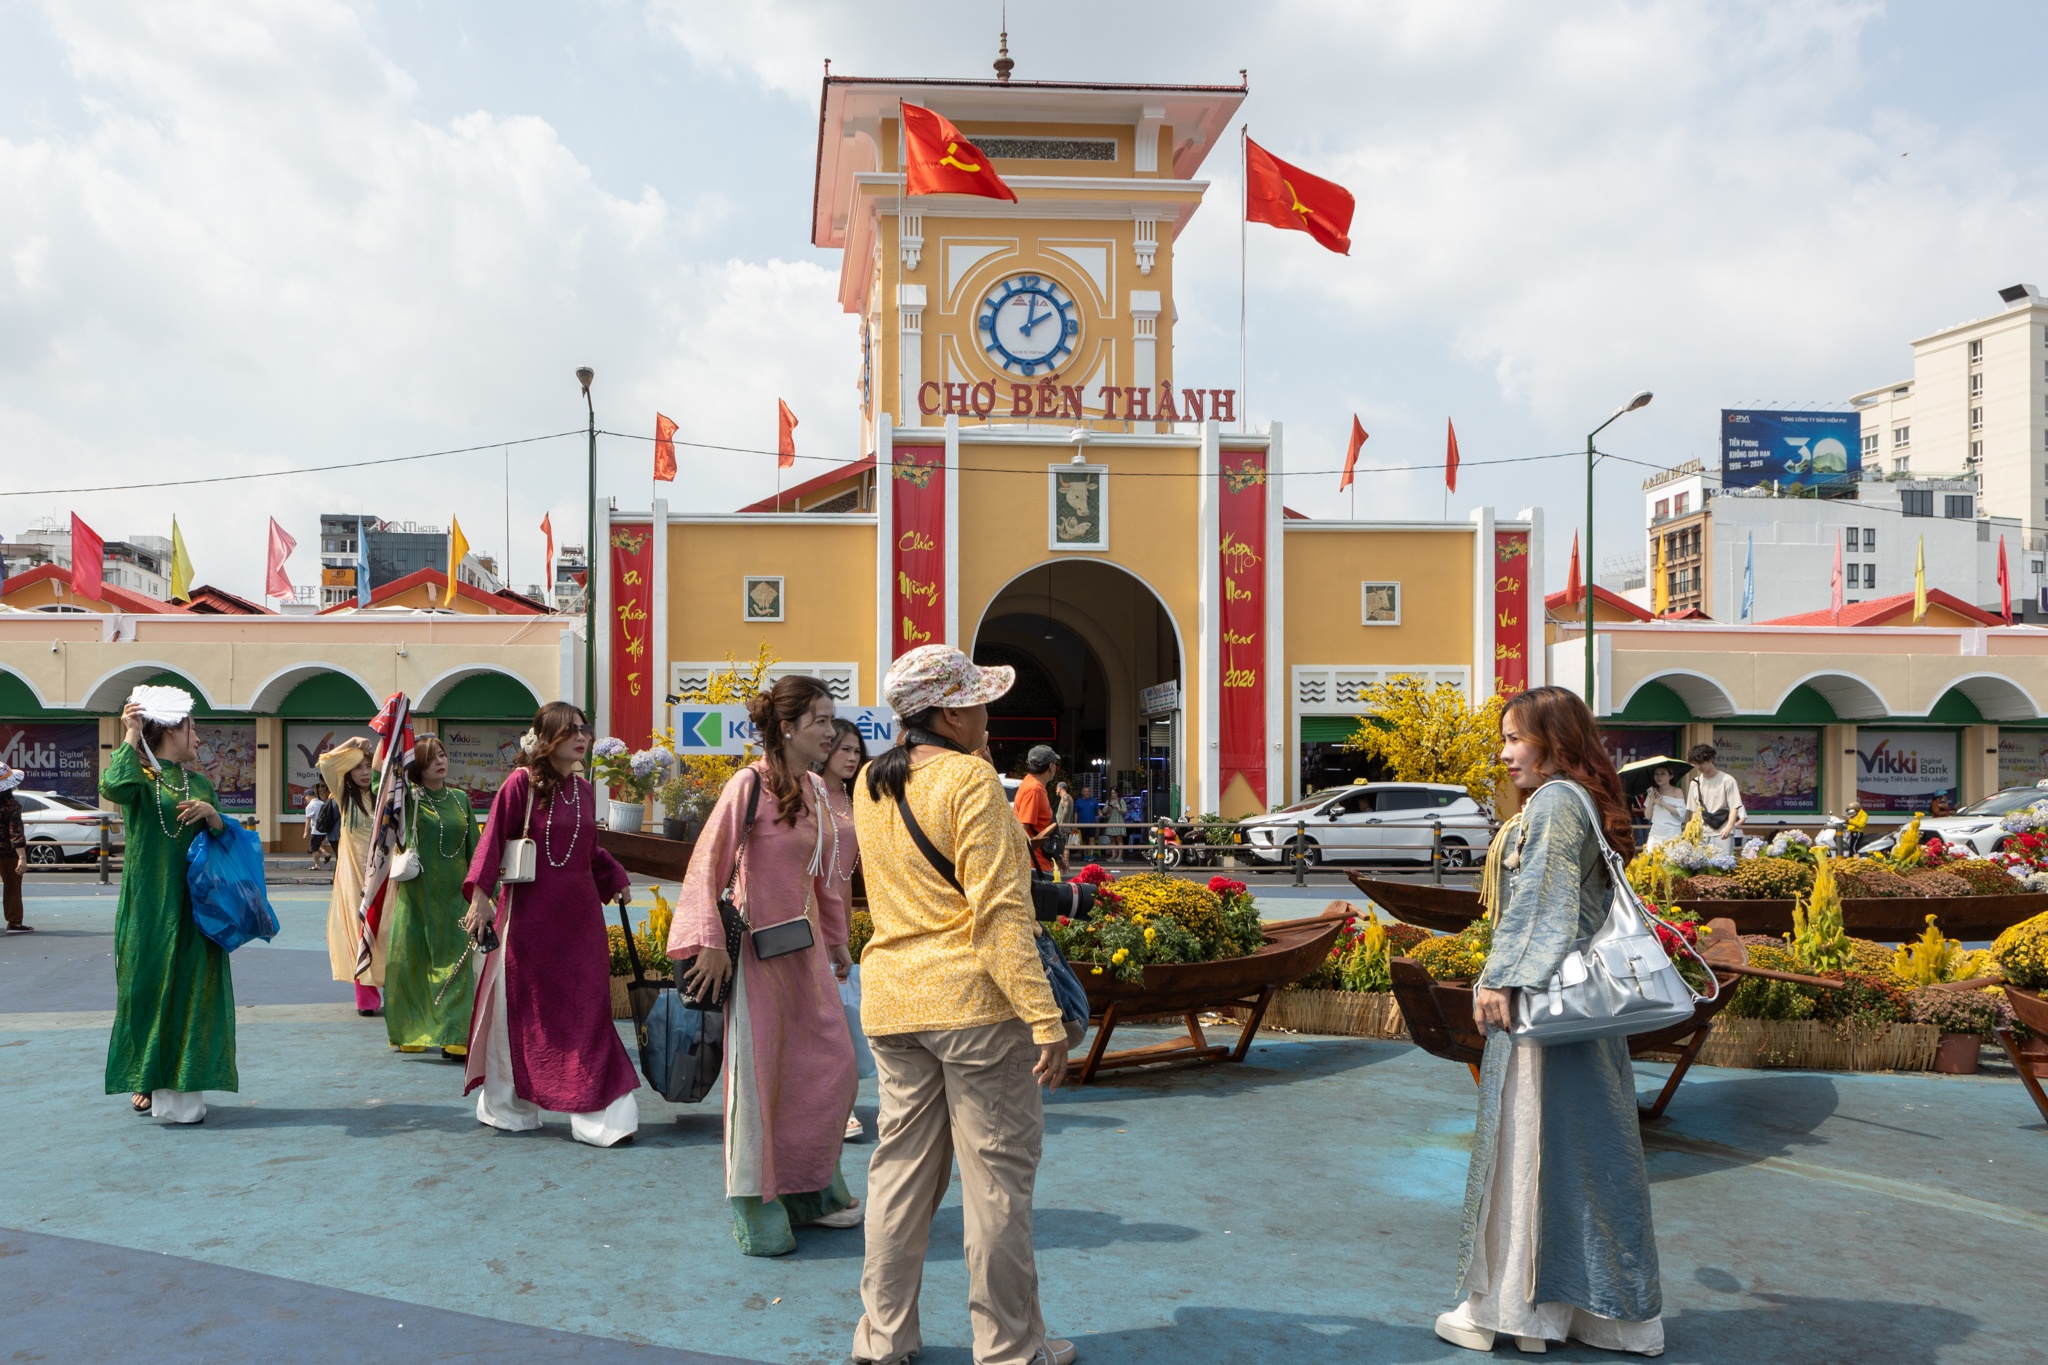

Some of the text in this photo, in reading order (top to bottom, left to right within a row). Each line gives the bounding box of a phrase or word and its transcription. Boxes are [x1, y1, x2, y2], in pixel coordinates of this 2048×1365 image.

[1019, 276, 1041, 292] 12
[978, 315, 993, 331] 9
[1064, 319, 1078, 335] 3
[1021, 361, 1036, 376] 6
[917, 373, 1236, 422] CHỢ BẾN THÀNH
[1741, 439, 1758, 447] PHONG
[1729, 449, 1747, 458] KHÔNG
[1760, 450, 1770, 458] HẠN
[1671, 458, 1701, 480] HOTEL
[1729, 462, 1742, 470] 1996
[368, 520, 416, 532] AVANTI
[898, 530, 936, 552] Chúc
[1219, 530, 1262, 574] Happy
[1225, 576, 1252, 604] New
[618, 598, 648, 640] Xuân
[1498, 606, 1518, 628] Vui
[1223, 669, 1256, 688] 2026
[449, 731, 470, 743] Vikki
[60, 758, 90, 768] Bank
[1857, 738, 1917, 774] Vikki
[41, 770, 58, 778] kiệm
[60, 770, 71, 778] Tốt
[1920, 765, 1948, 774] Bank
